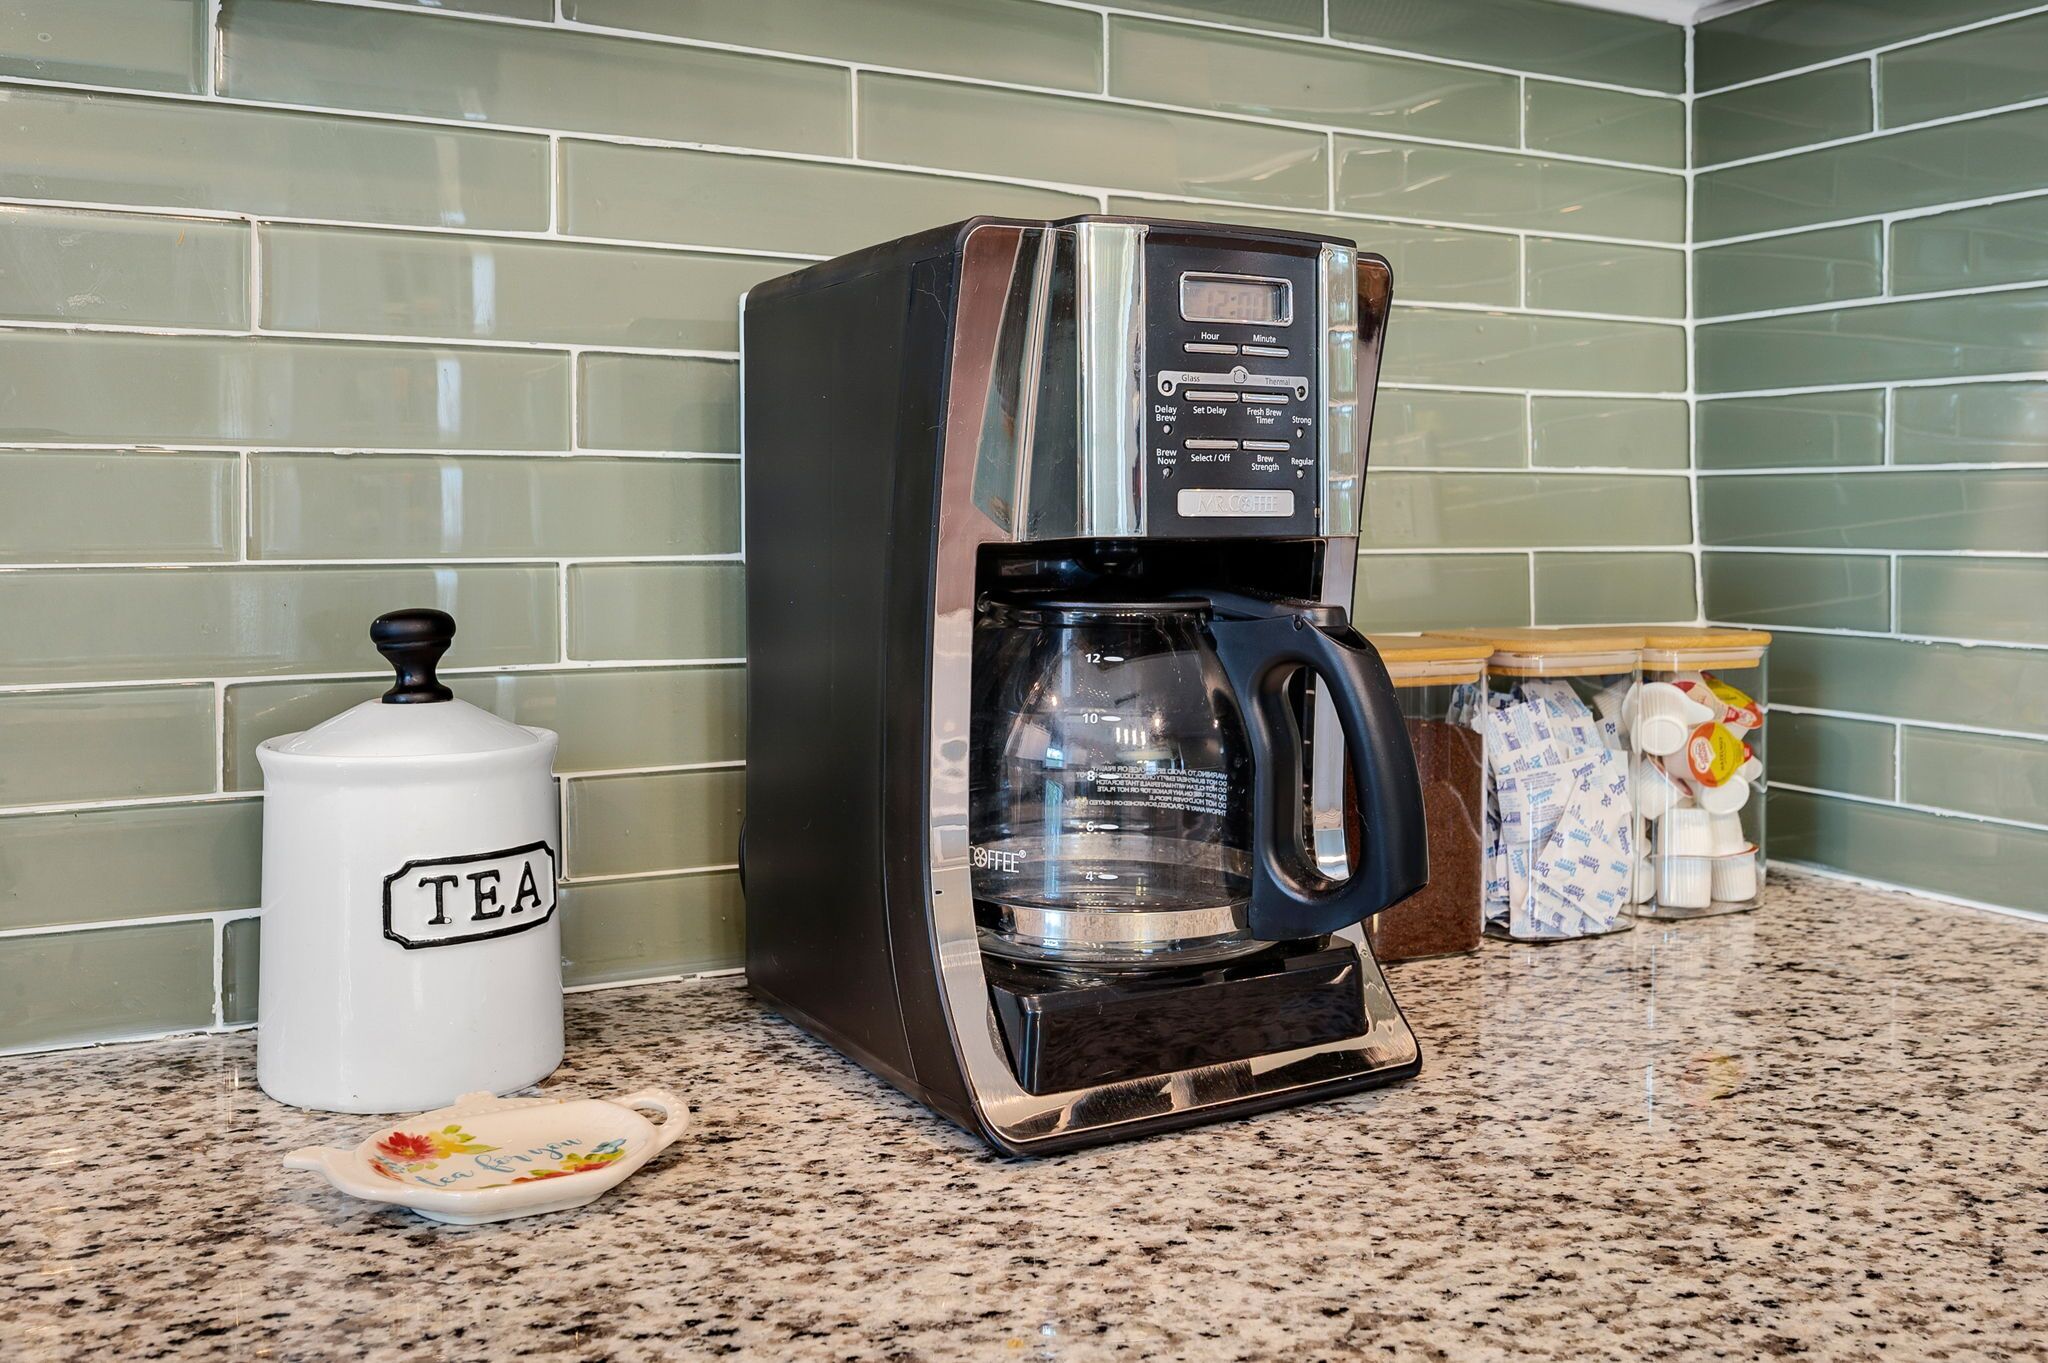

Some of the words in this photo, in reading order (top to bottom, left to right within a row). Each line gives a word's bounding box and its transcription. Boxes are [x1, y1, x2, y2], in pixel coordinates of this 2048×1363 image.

[1201, 332, 1220, 341] Hour
[1252, 334, 1276, 344] Minute
[1182, 373, 1200, 382] Glass
[1265, 377, 1291, 386] Thermal
[1155, 405, 1177, 415] Delay
[1193, 406, 1205, 414] Set
[1206, 406, 1227, 416] Delay
[1247, 408, 1265, 416] Fresh
[1265, 408, 1282, 416] Brew
[1156, 414, 1176, 422] Brew
[1256, 416, 1275, 424] Timer
[1292, 416, 1312, 425] Strong
[1156, 448, 1177, 456] Brew
[1157, 457, 1176, 465] Now
[1191, 454, 1213, 462] Select
[1218, 454, 1231, 462] Off
[1291, 457, 1314, 467] Regular
[1252, 463, 1279, 472] Strength
[1085, 653, 1100, 663] 12
[1082, 713, 1098, 724] 10
[1087, 770, 1095, 781] 8
[1086, 821, 1094, 832] 6
[1085, 871, 1094, 881] 4
[418, 861, 542, 925] TEA
[416, 1170, 474, 1187] tea
[474, 1155, 532, 1173] for
[529, 1137, 582, 1160] you
